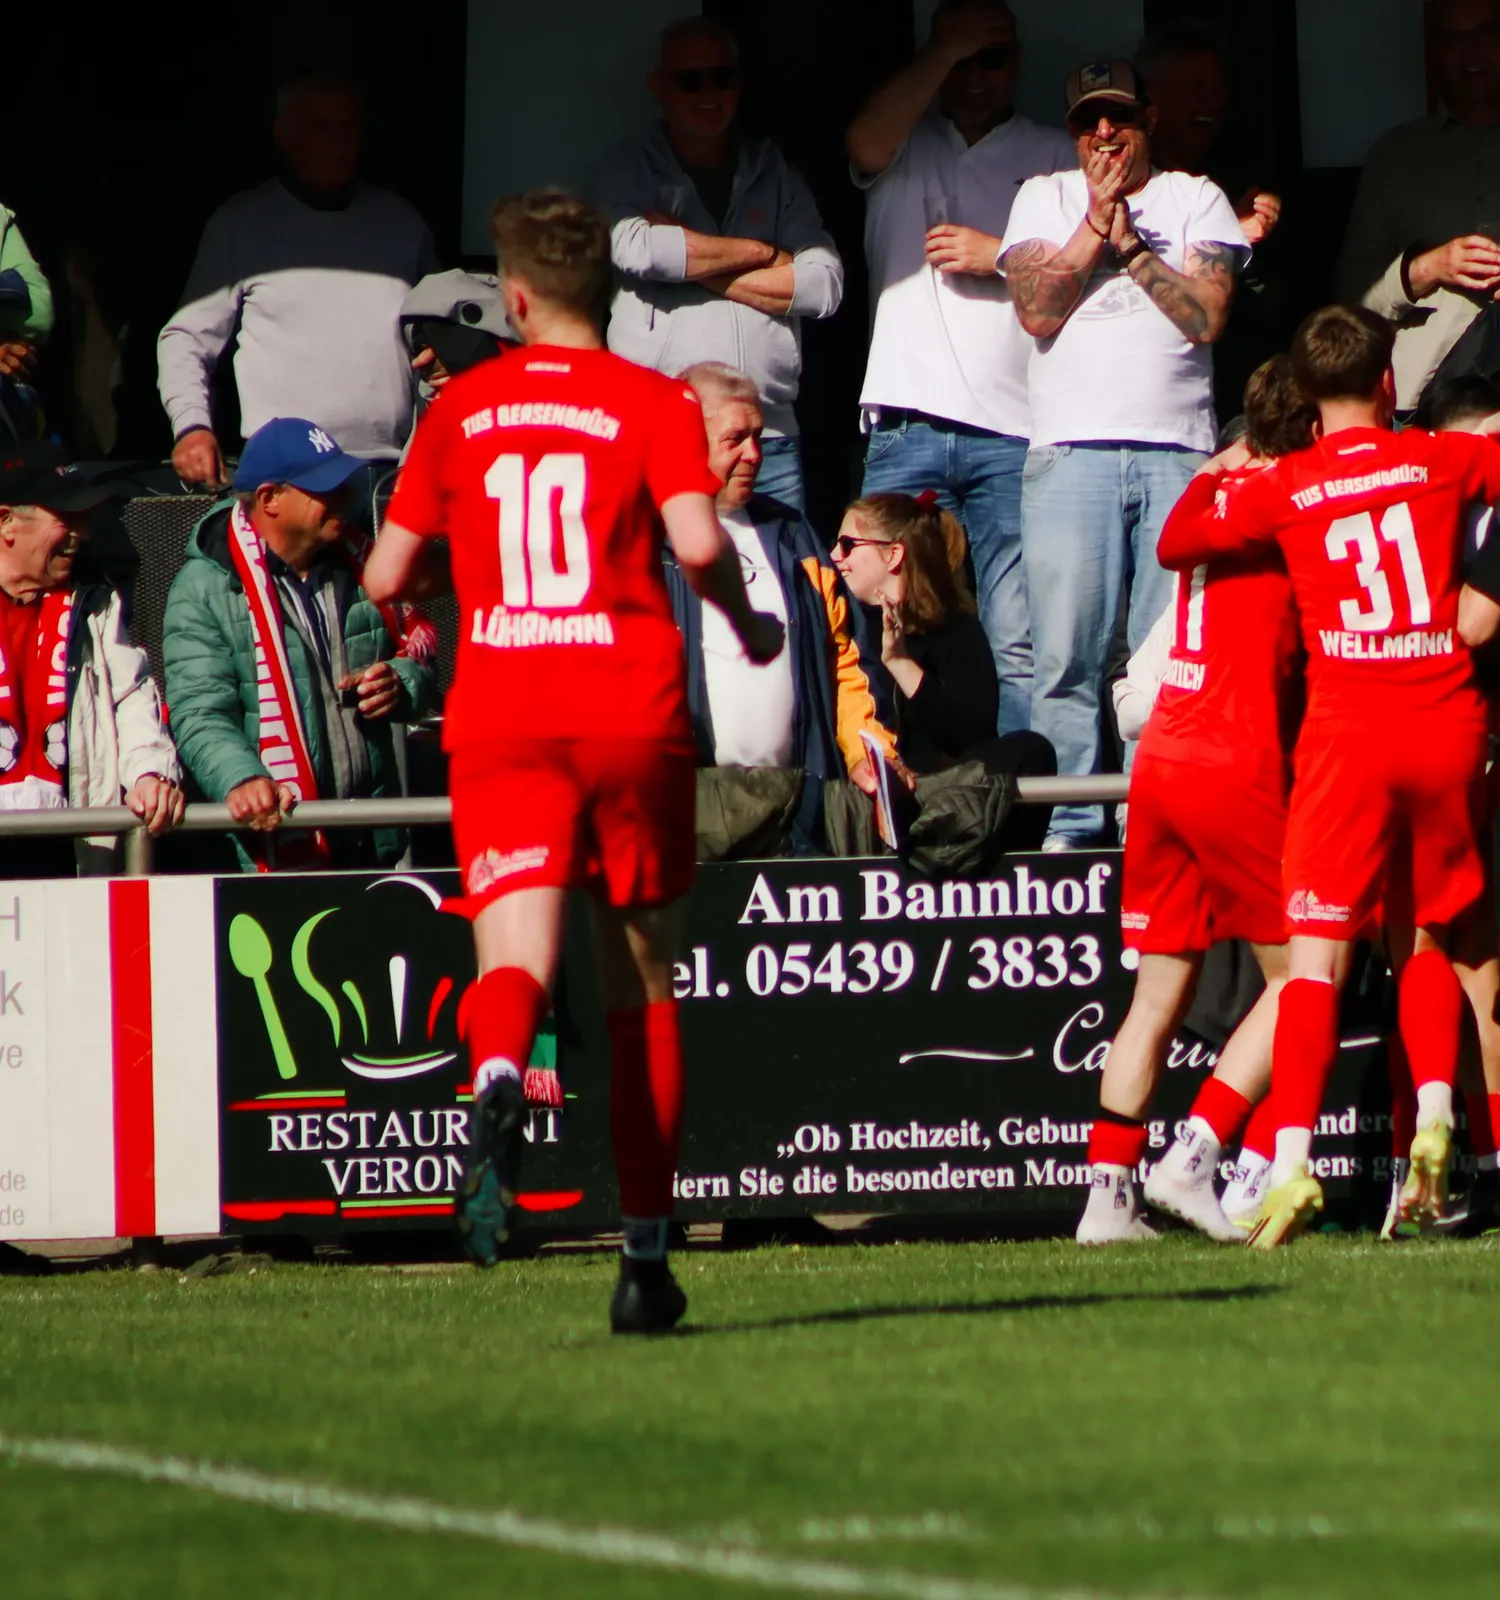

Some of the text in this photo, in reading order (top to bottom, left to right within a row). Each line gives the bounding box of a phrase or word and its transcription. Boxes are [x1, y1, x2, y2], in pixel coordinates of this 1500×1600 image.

[461, 408, 493, 439] TUS
[1290, 484, 1323, 510] TUS
[484, 453, 592, 608] 10
[1325, 501, 1431, 632] 31
[1319, 628, 1453, 660] WELLMANN
[1163, 659, 1206, 691] RICH
[738, 864, 1112, 924] Am Bannhof
[673, 947, 730, 999] el.
[745, 941, 914, 996] 05439
[967, 935, 1101, 988] 3833
[268, 1108, 564, 1151] RESTAURNT
[850, 1119, 991, 1150] Hochzeit,
[321, 1154, 464, 1195] VERON
[740, 1167, 783, 1197] Sie
[793, 1165, 837, 1195] die
[847, 1161, 1014, 1193] besonderen
